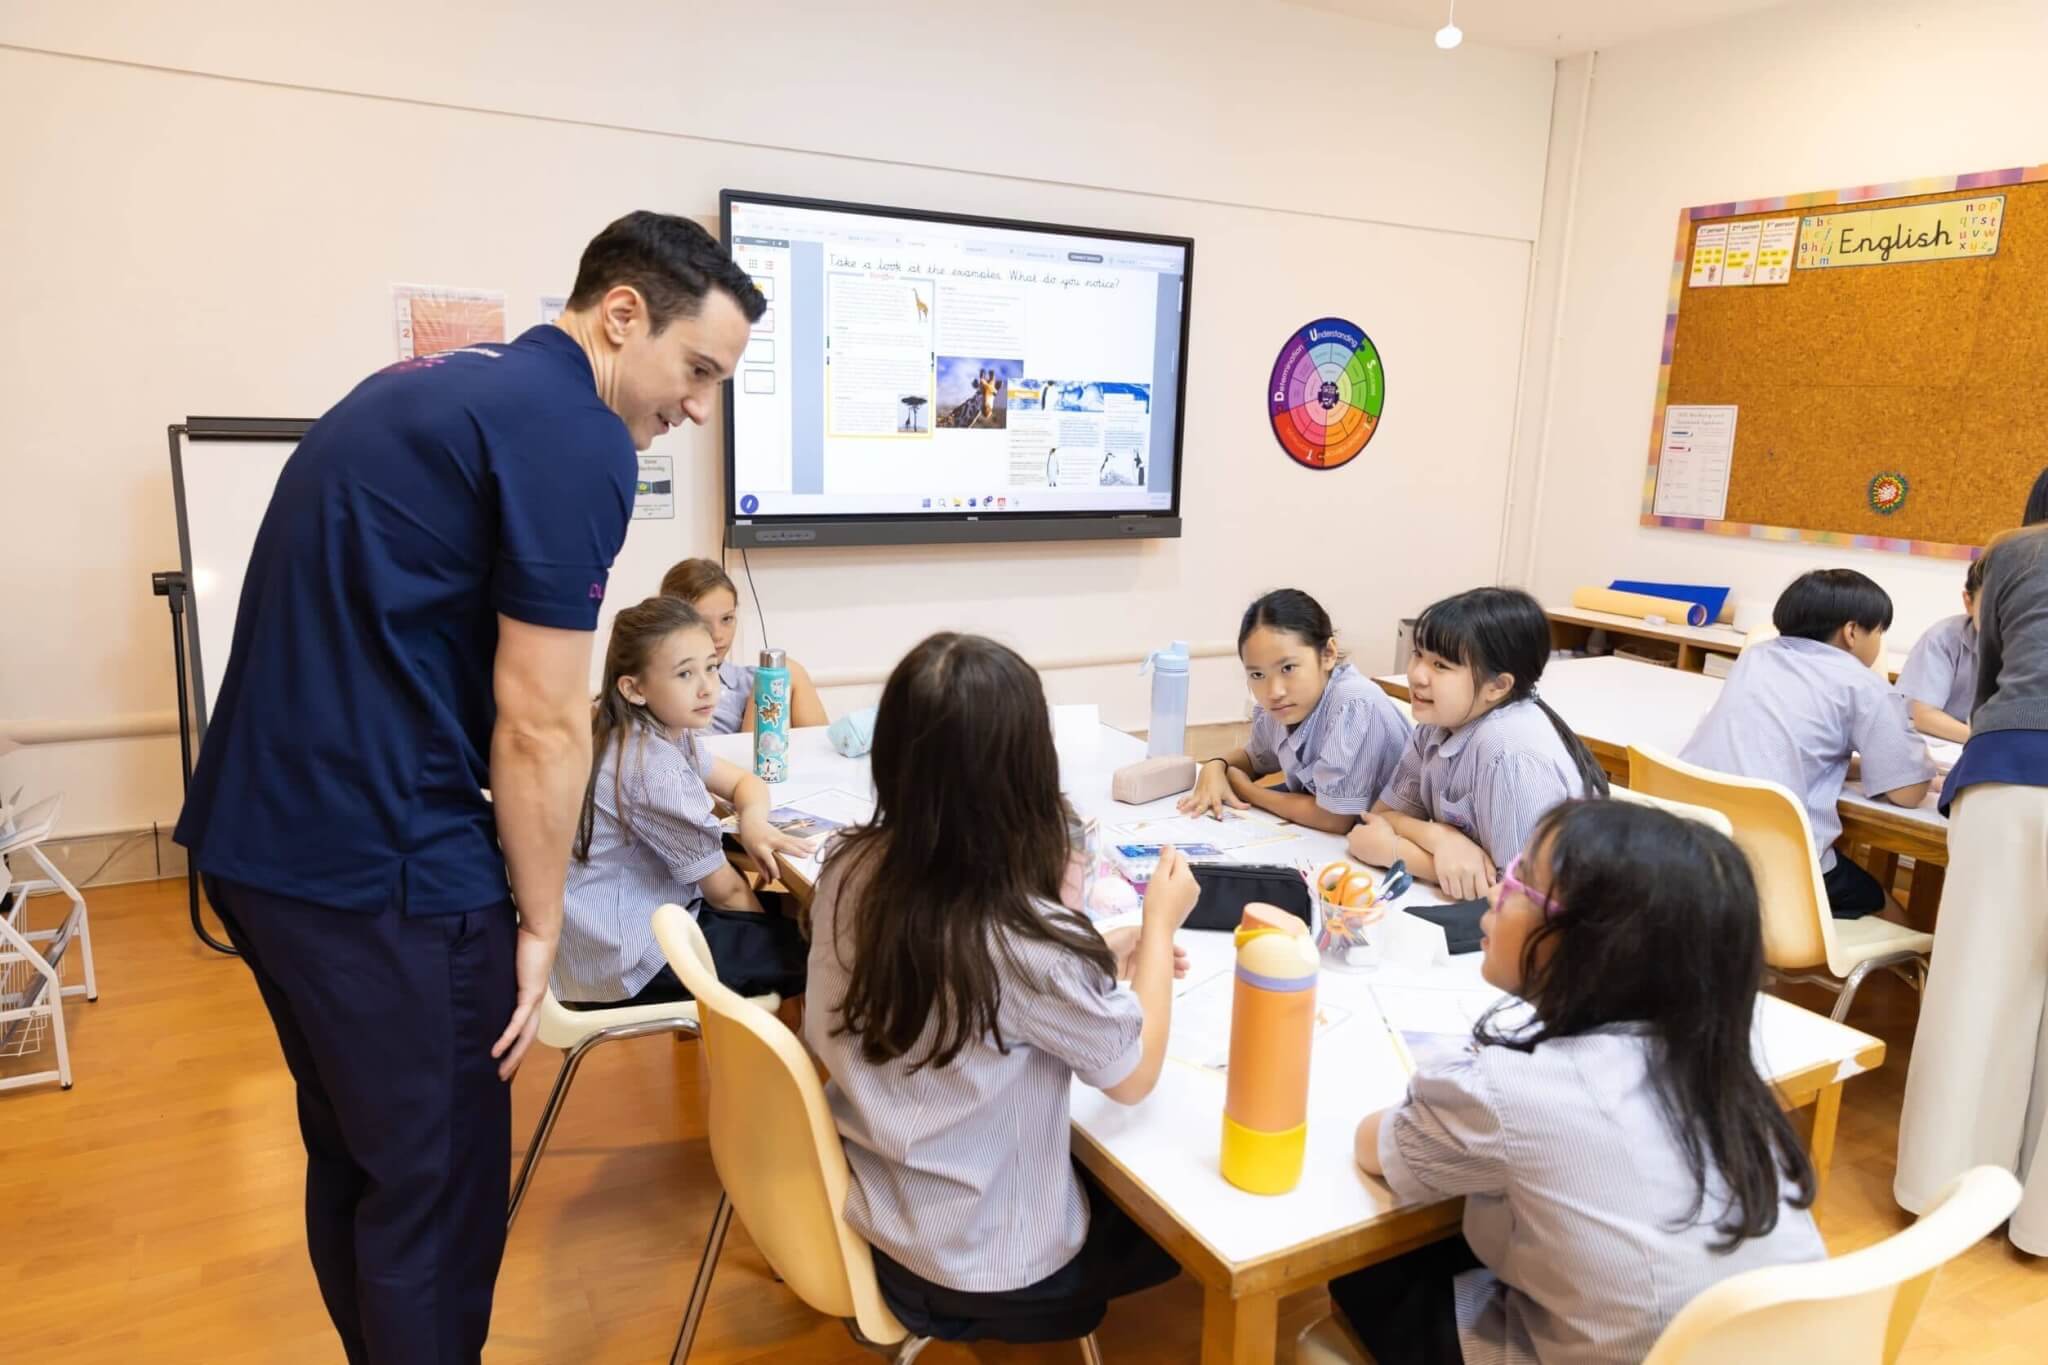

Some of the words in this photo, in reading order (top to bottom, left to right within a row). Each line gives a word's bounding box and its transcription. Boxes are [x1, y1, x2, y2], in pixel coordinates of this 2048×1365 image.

[1839, 219, 1953, 262] English
[829, 253, 857, 268] Take
[863, 261, 871, 270] a
[878, 257, 902, 272] look
[908, 264, 921, 274] at
[927, 263, 945, 275] the
[1009, 268, 1037, 283] What
[1042, 273, 1057, 284] do
[1061, 278, 1081, 290] you
[1084, 278, 1120, 289] notice?
[1309, 327, 1358, 348] Understanding
[1273, 344, 1305, 402] Determination
